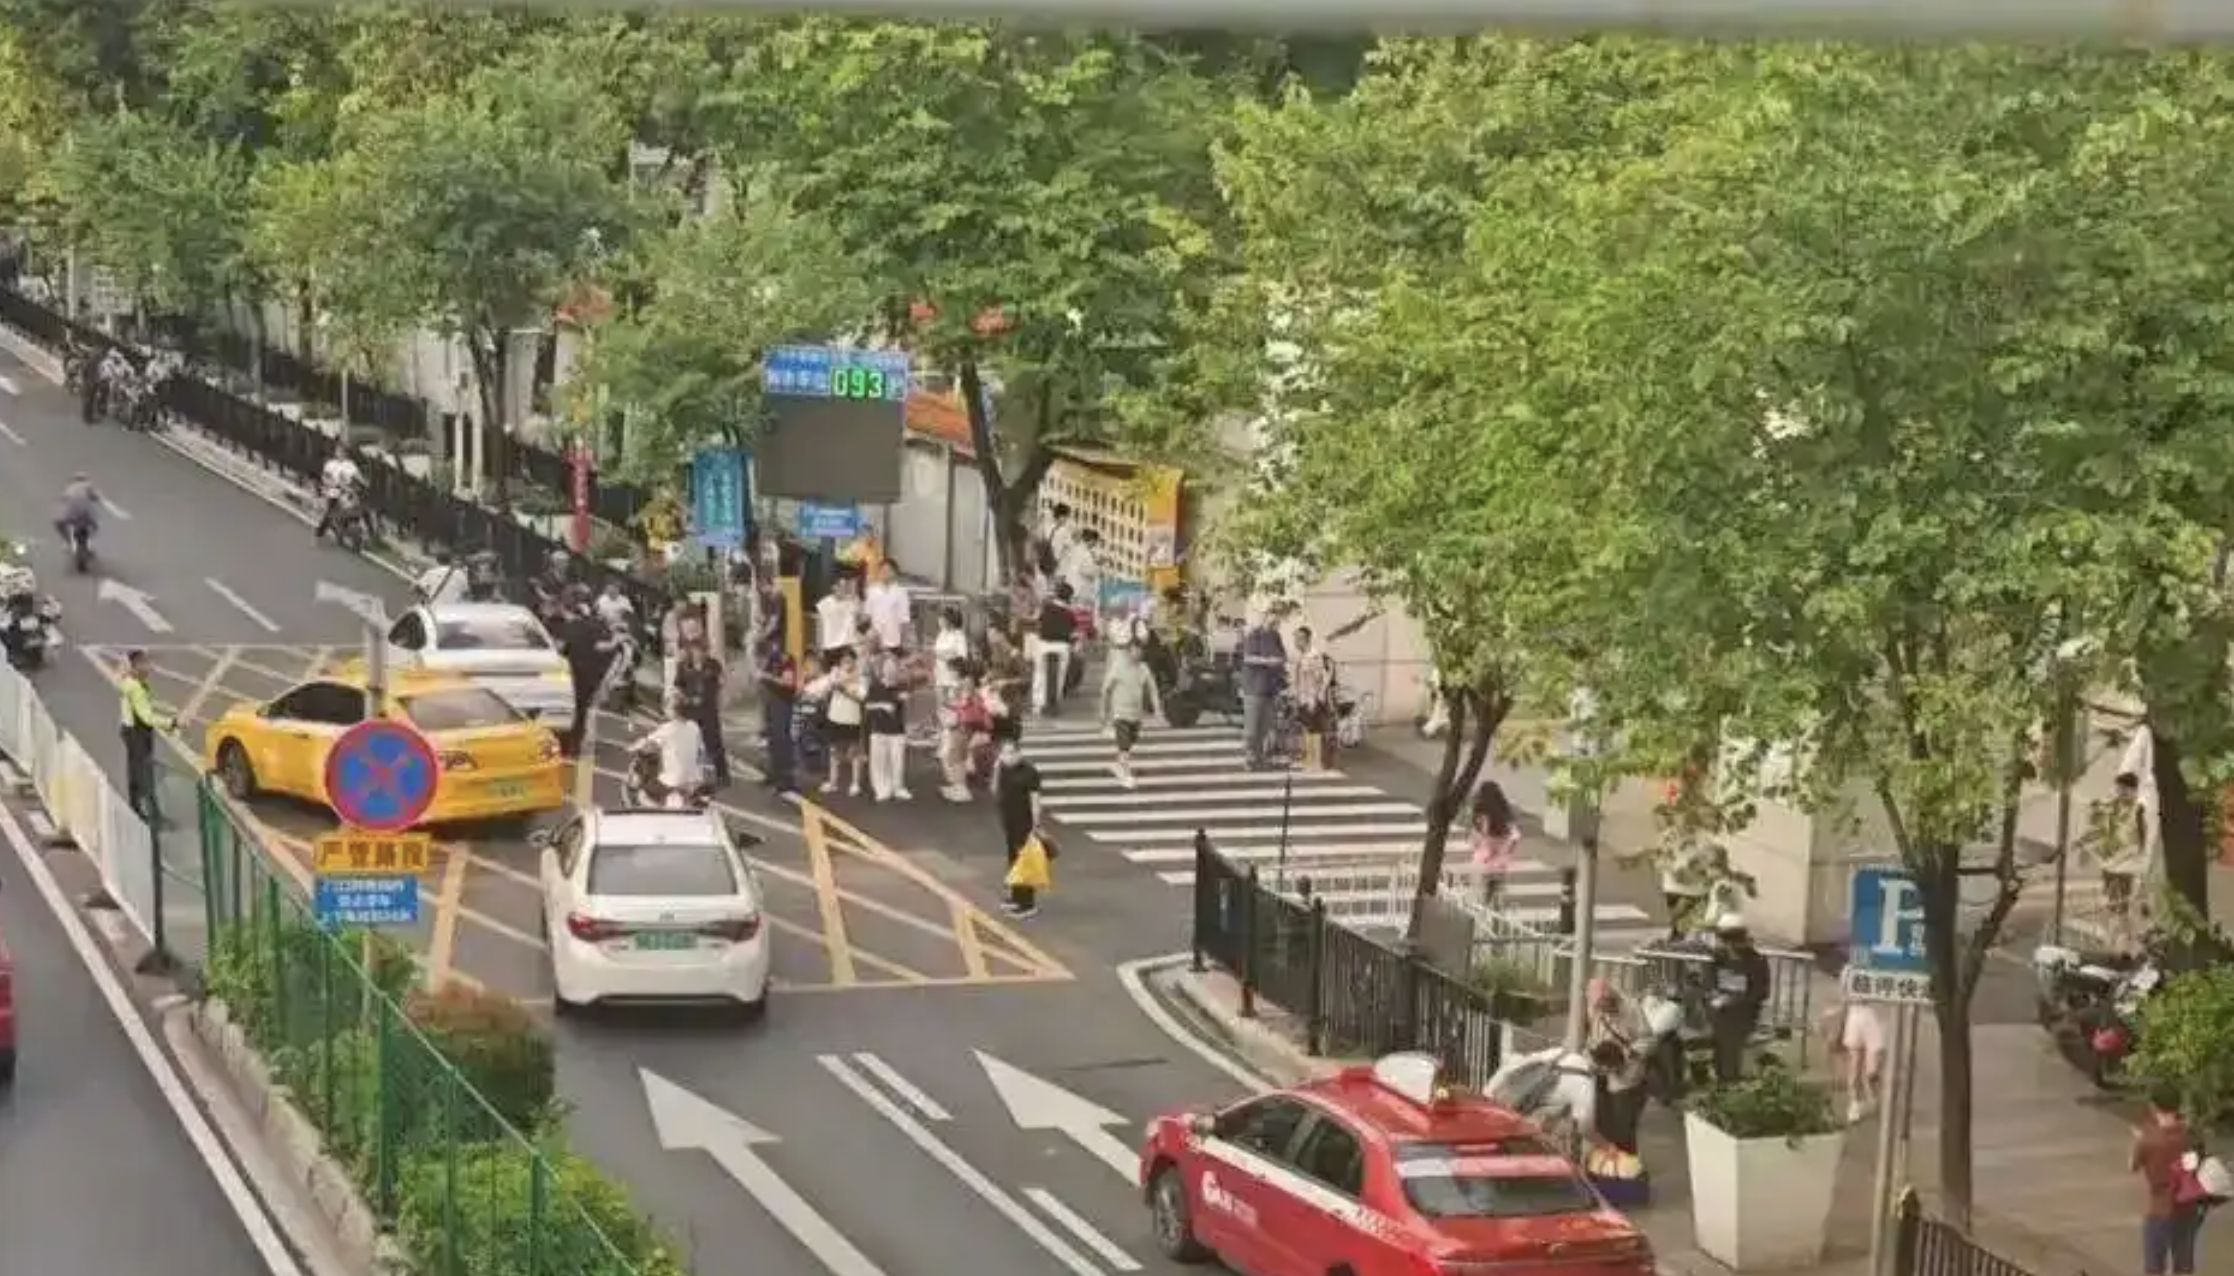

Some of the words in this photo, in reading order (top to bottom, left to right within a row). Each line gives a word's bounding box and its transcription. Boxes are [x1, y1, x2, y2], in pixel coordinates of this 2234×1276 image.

[833, 368, 883, 398] 093
[319, 840, 424, 867] 严管路段
